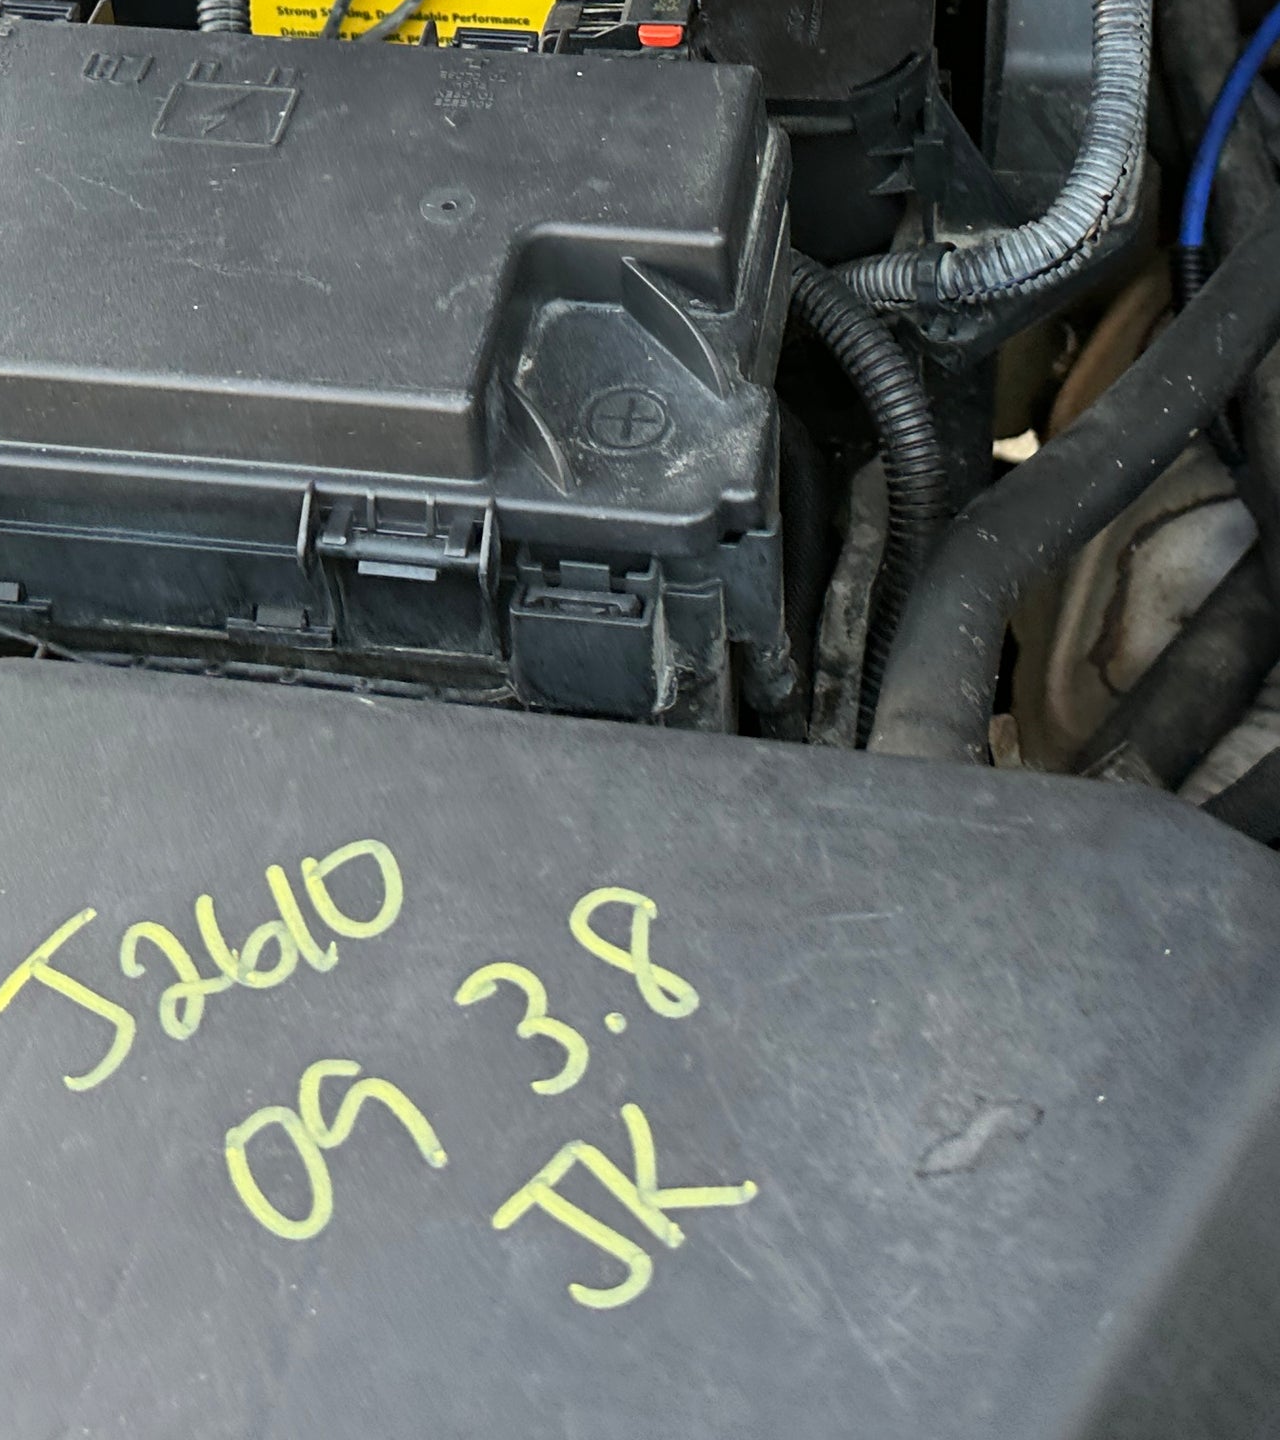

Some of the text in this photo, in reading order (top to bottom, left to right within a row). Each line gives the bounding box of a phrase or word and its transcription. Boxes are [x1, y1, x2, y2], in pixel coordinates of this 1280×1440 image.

[276, 4, 319, 22] Strong
[452, 12, 531, 28] Performance
[454, 886, 701, 1096] 3.8
[224, 1058, 448, 1241] 09
[491, 1102, 759, 1310] JK
